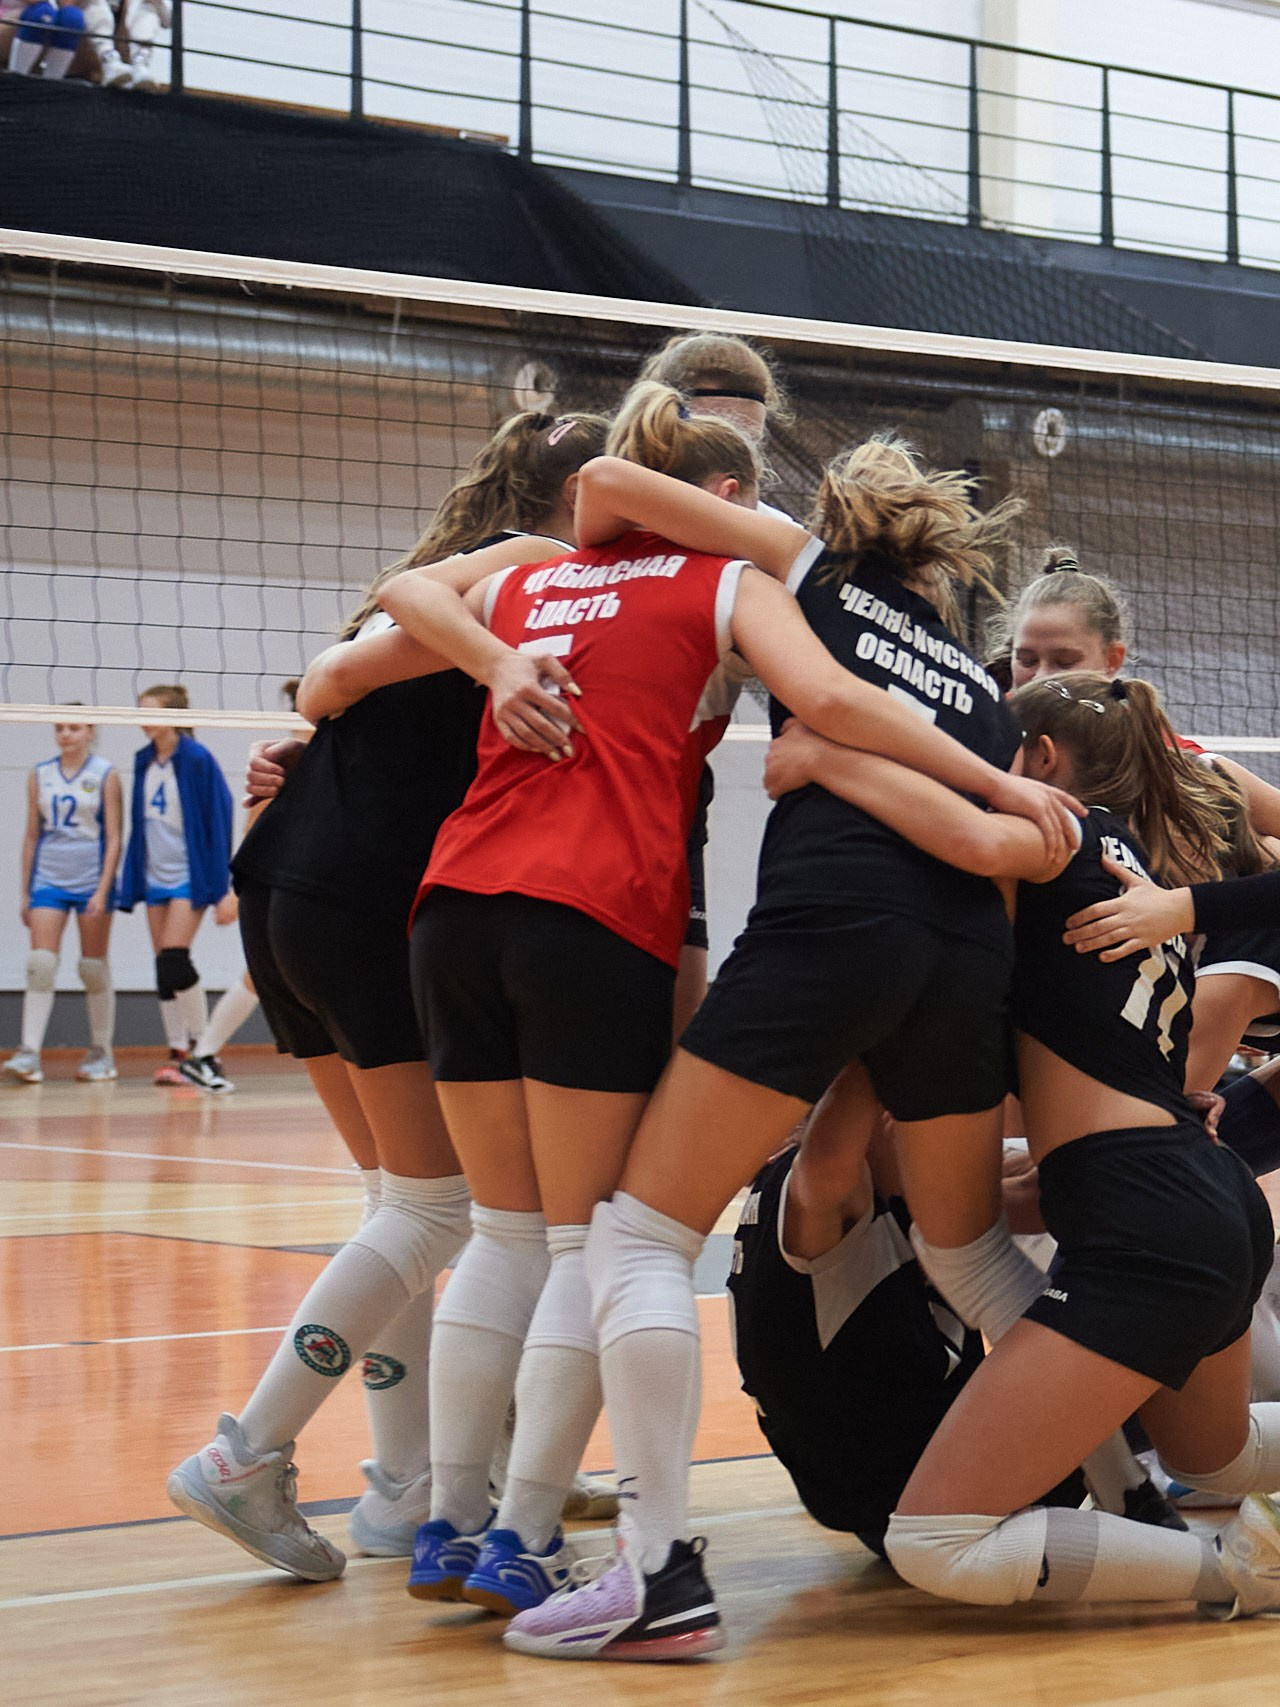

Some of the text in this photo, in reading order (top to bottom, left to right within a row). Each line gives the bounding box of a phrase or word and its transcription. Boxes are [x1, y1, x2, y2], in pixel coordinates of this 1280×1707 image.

[855, 632, 974, 715] ОБЛАСТЬ
[52, 794, 79, 828] 12
[150, 781, 167, 815] 4
